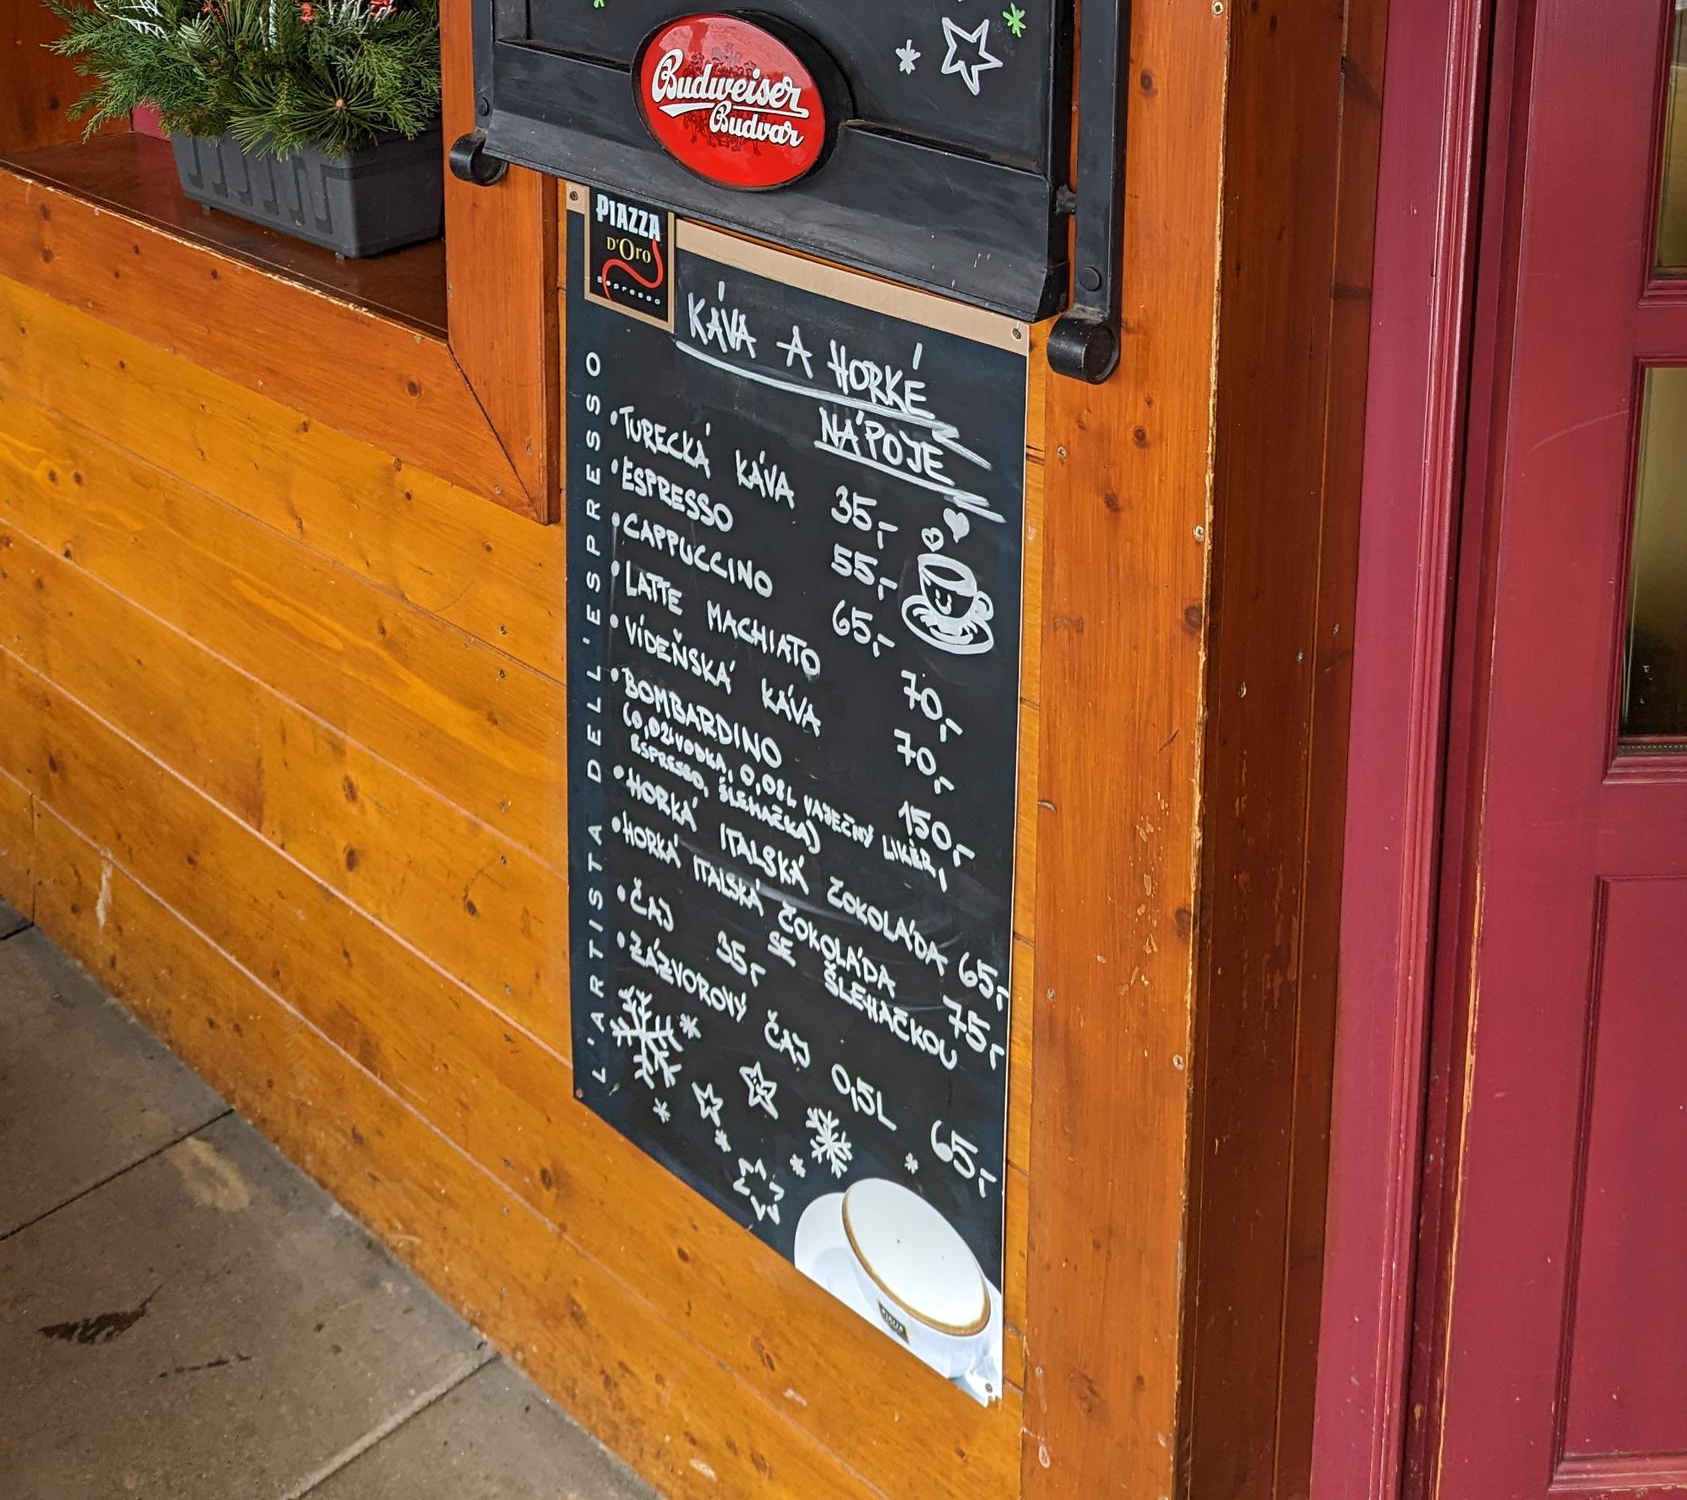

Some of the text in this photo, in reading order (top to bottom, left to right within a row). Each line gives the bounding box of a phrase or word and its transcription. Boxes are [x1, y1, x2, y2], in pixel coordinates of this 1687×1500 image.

[652, 49, 809, 118] Budweiser
[709, 100, 804, 147] Budvar
[596, 193, 661, 242] PIAZZA
[687, 280, 935, 420] KÁVA A HORKÉ
[619, 405, 898, 550] TURECKÁ KÁVA 35,-
[819, 406, 956, 487] NÁPOJE
[622, 455, 898, 601] ESPRESSO 55,-
[623, 513, 896, 658] CAPPUCCINO 65,-
[625, 560, 963, 742] LATTE MACHIATO 70,-
[625, 614, 955, 795] VÍDEŇSKÁ KÁVA 70,-
[622, 667, 976, 868] BOMBARDINO 150,-
[622, 810, 1005, 1071] HORKÁ ITALSKÁ ČOKOLÁDA 75,-
[626, 767, 698, 832] HORKÁ
[720, 823, 810, 895] ITALSKÁ
[826, 875, 948, 977] ČOKOLÁDA
[630, 877, 674, 932] ČAJ
[629, 930, 746, 1023] ZÁZVOROVÝ
[764, 1009, 811, 1068] ČAJ
[767, 931, 957, 1070] SE ŠLEHAČKOU
